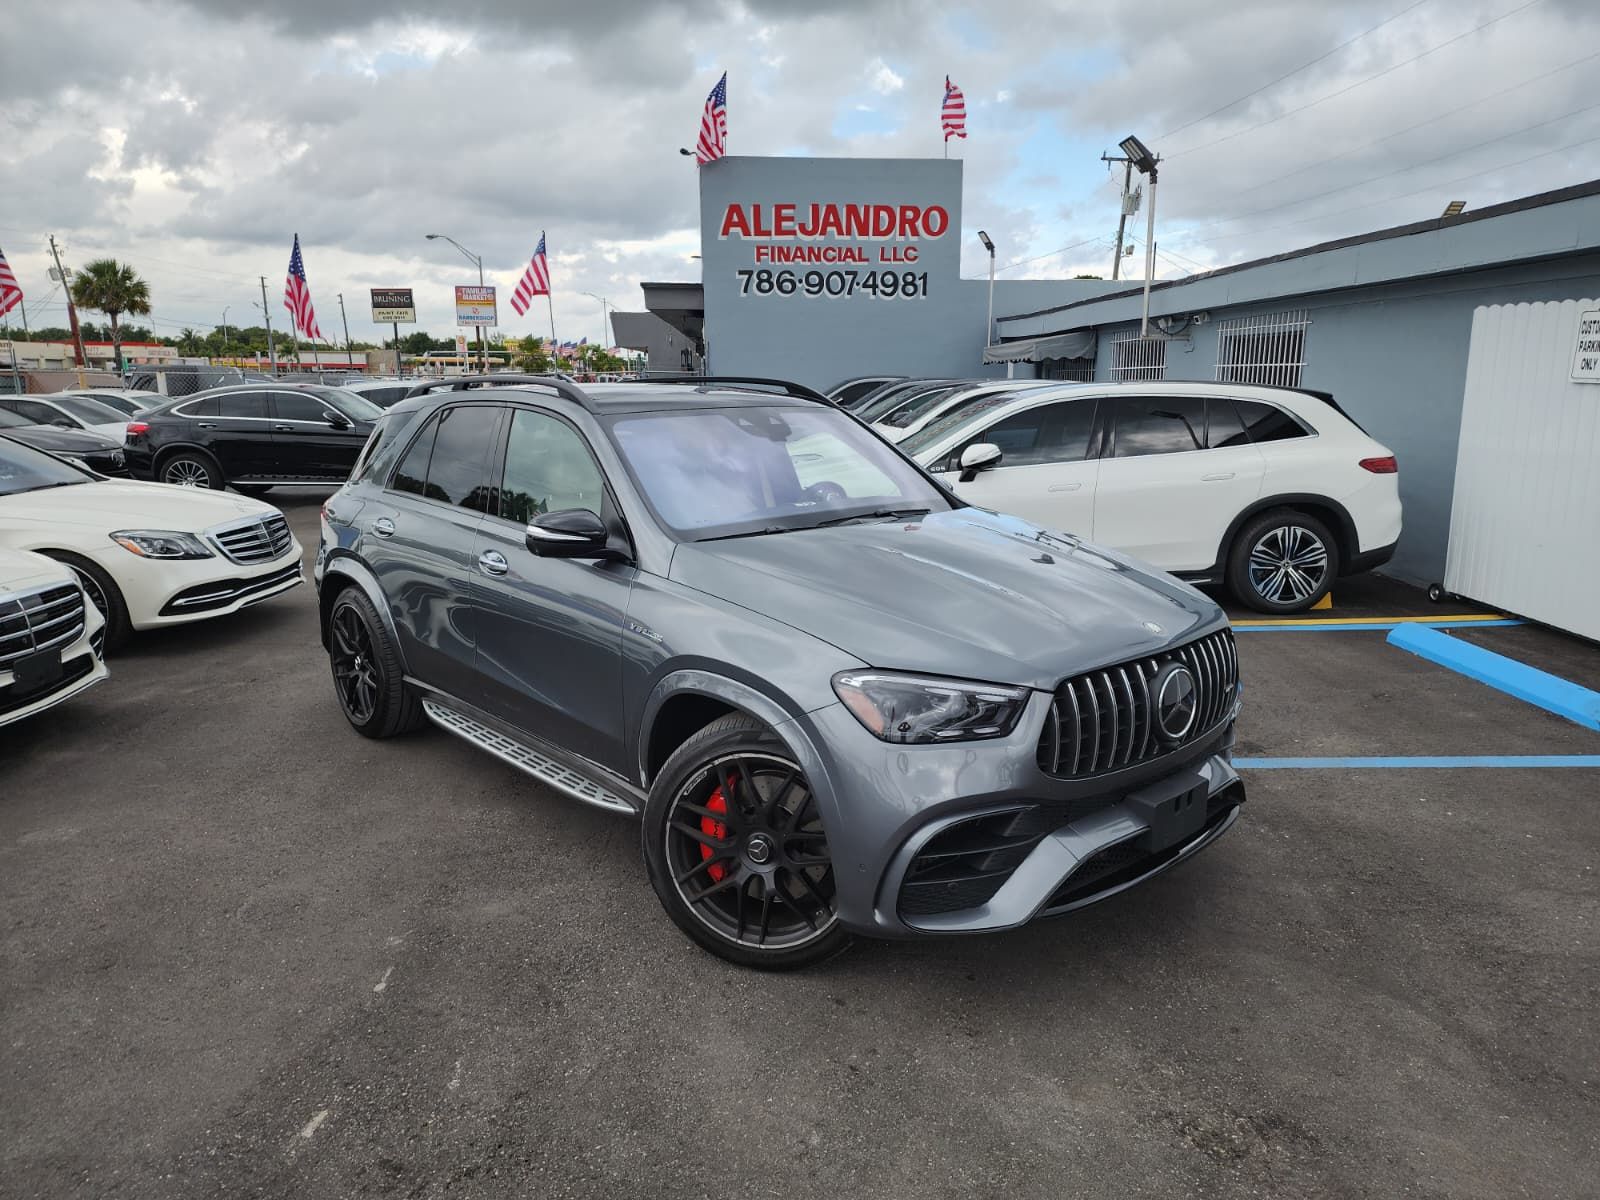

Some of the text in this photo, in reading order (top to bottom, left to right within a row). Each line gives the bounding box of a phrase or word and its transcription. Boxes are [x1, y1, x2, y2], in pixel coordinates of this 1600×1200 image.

[719, 203, 949, 240] ALEJANDRO
[755, 245, 919, 265] FINANCIAL LLC
[1580, 358, 1599, 371] ONLY
